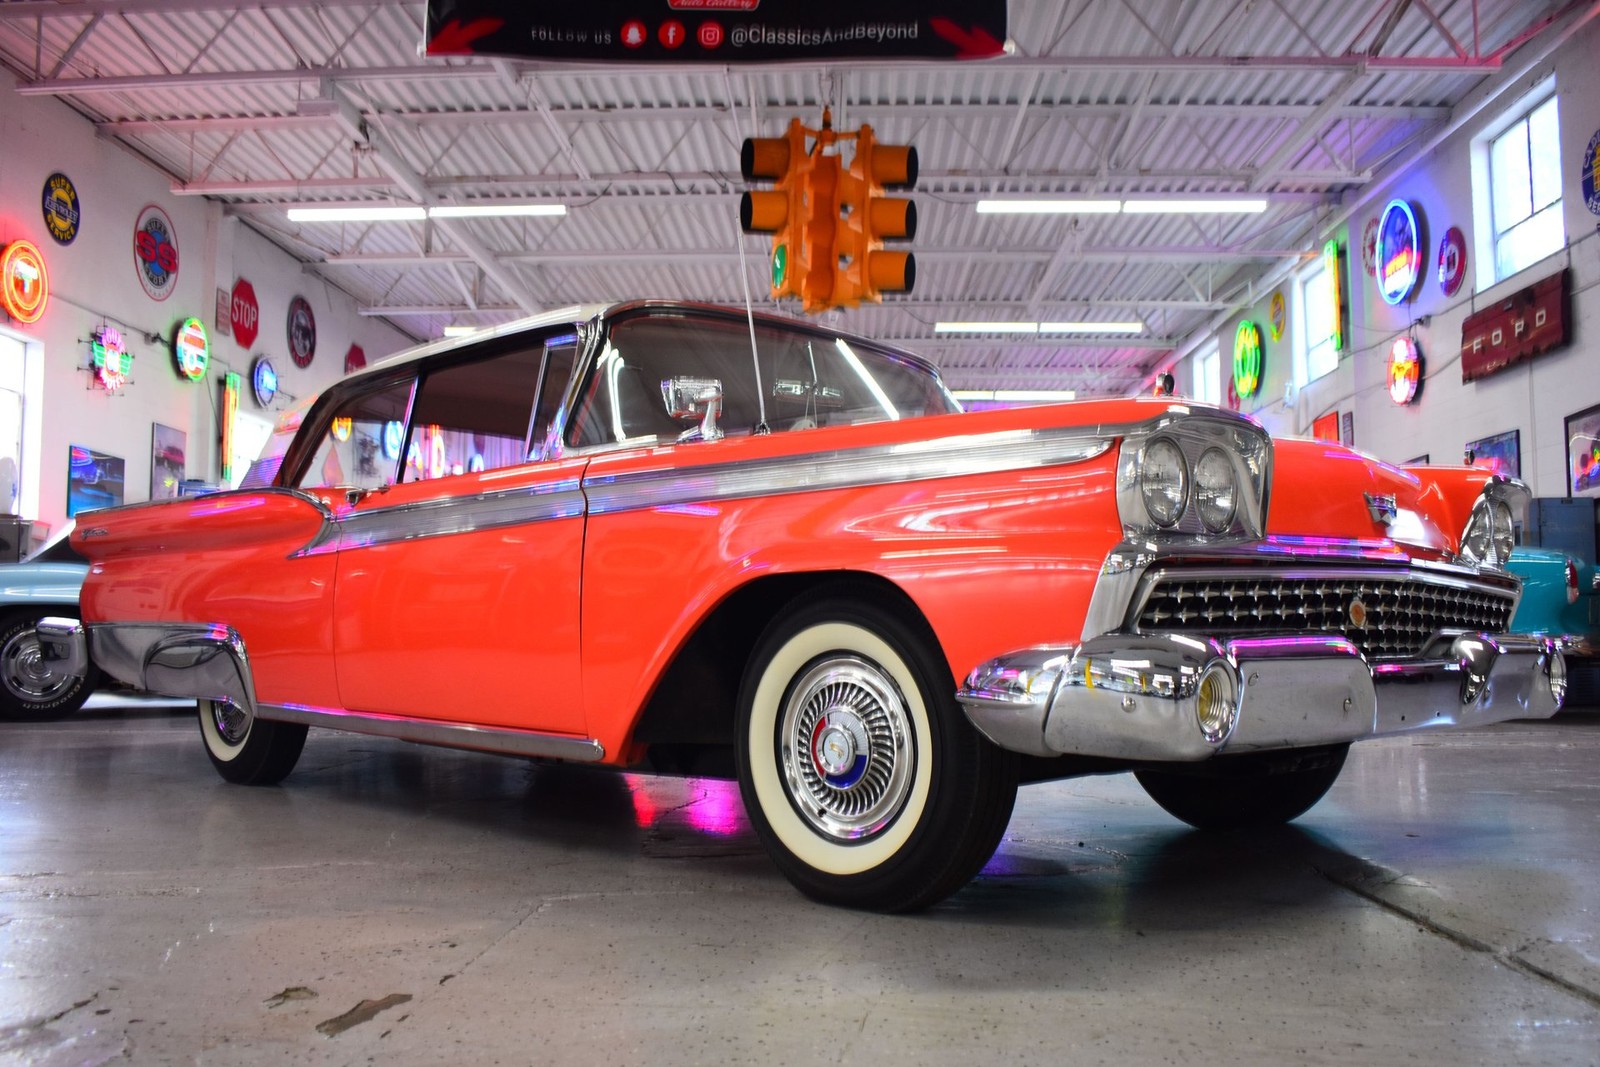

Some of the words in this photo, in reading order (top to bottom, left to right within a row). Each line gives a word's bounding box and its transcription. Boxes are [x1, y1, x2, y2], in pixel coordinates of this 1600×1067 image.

[531, 27, 587, 42] FOLLOW
[594, 28, 612, 44] US
[731, 24, 918, 47] @ClassicsAndBeyond
[50, 177, 76, 200] SUPER
[47, 213, 75, 240] SERVICE
[137, 230, 177, 274] SS
[232, 298, 257, 331] STOP
